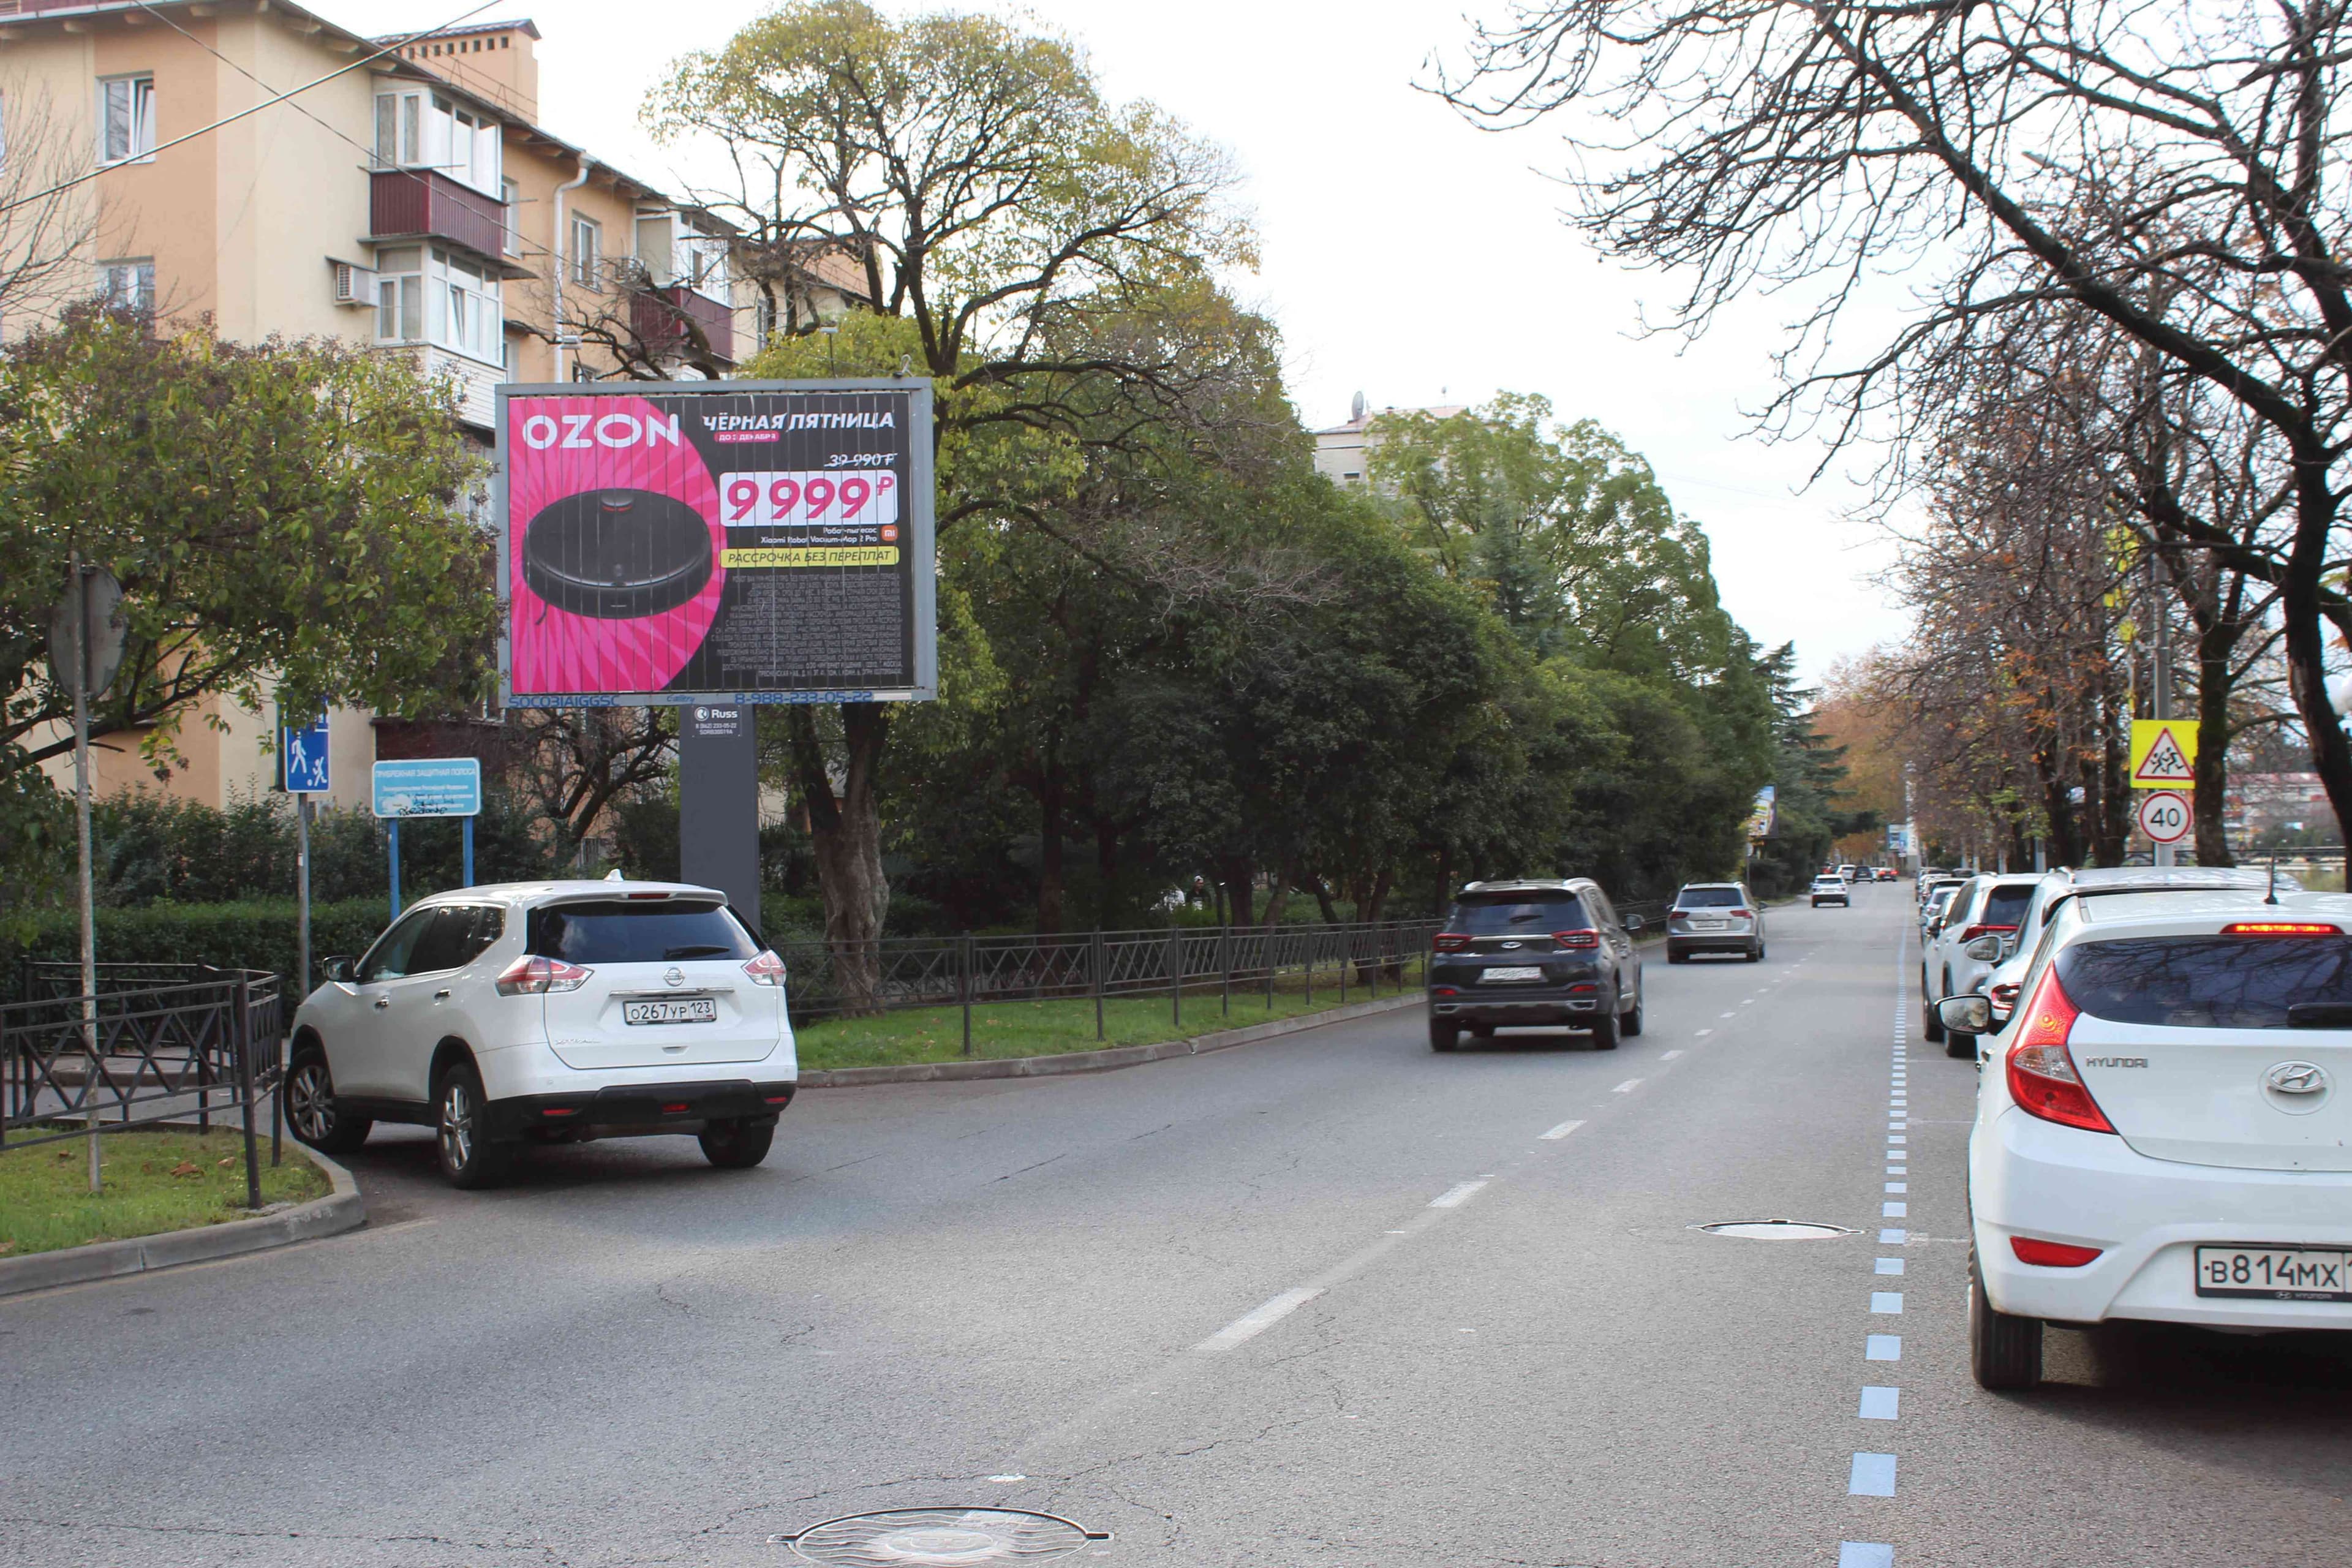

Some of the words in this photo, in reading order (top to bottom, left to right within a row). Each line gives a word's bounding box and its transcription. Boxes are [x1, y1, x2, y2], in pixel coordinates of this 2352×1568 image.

[703, 412, 787, 431] ЧЁРНАЯ
[786, 412, 895, 432] ПЯТНИЦА
[522, 413, 679, 450] OZON
[728, 552, 801, 563] РАССРОЧКА
[805, 552, 826, 562] БЕЗ
[829, 551, 891, 562] ПЕРЕПЛАТ
[736, 691, 873, 704] 8-988-233-05-22
[711, 709, 738, 718] Russ
[417, 768, 450, 777] ЗАЩИТНАЯ
[2150, 808, 2181, 827] 40
[690, 1002, 710, 1014] 123
[2086, 1057, 2148, 1068] HYUNDAI
